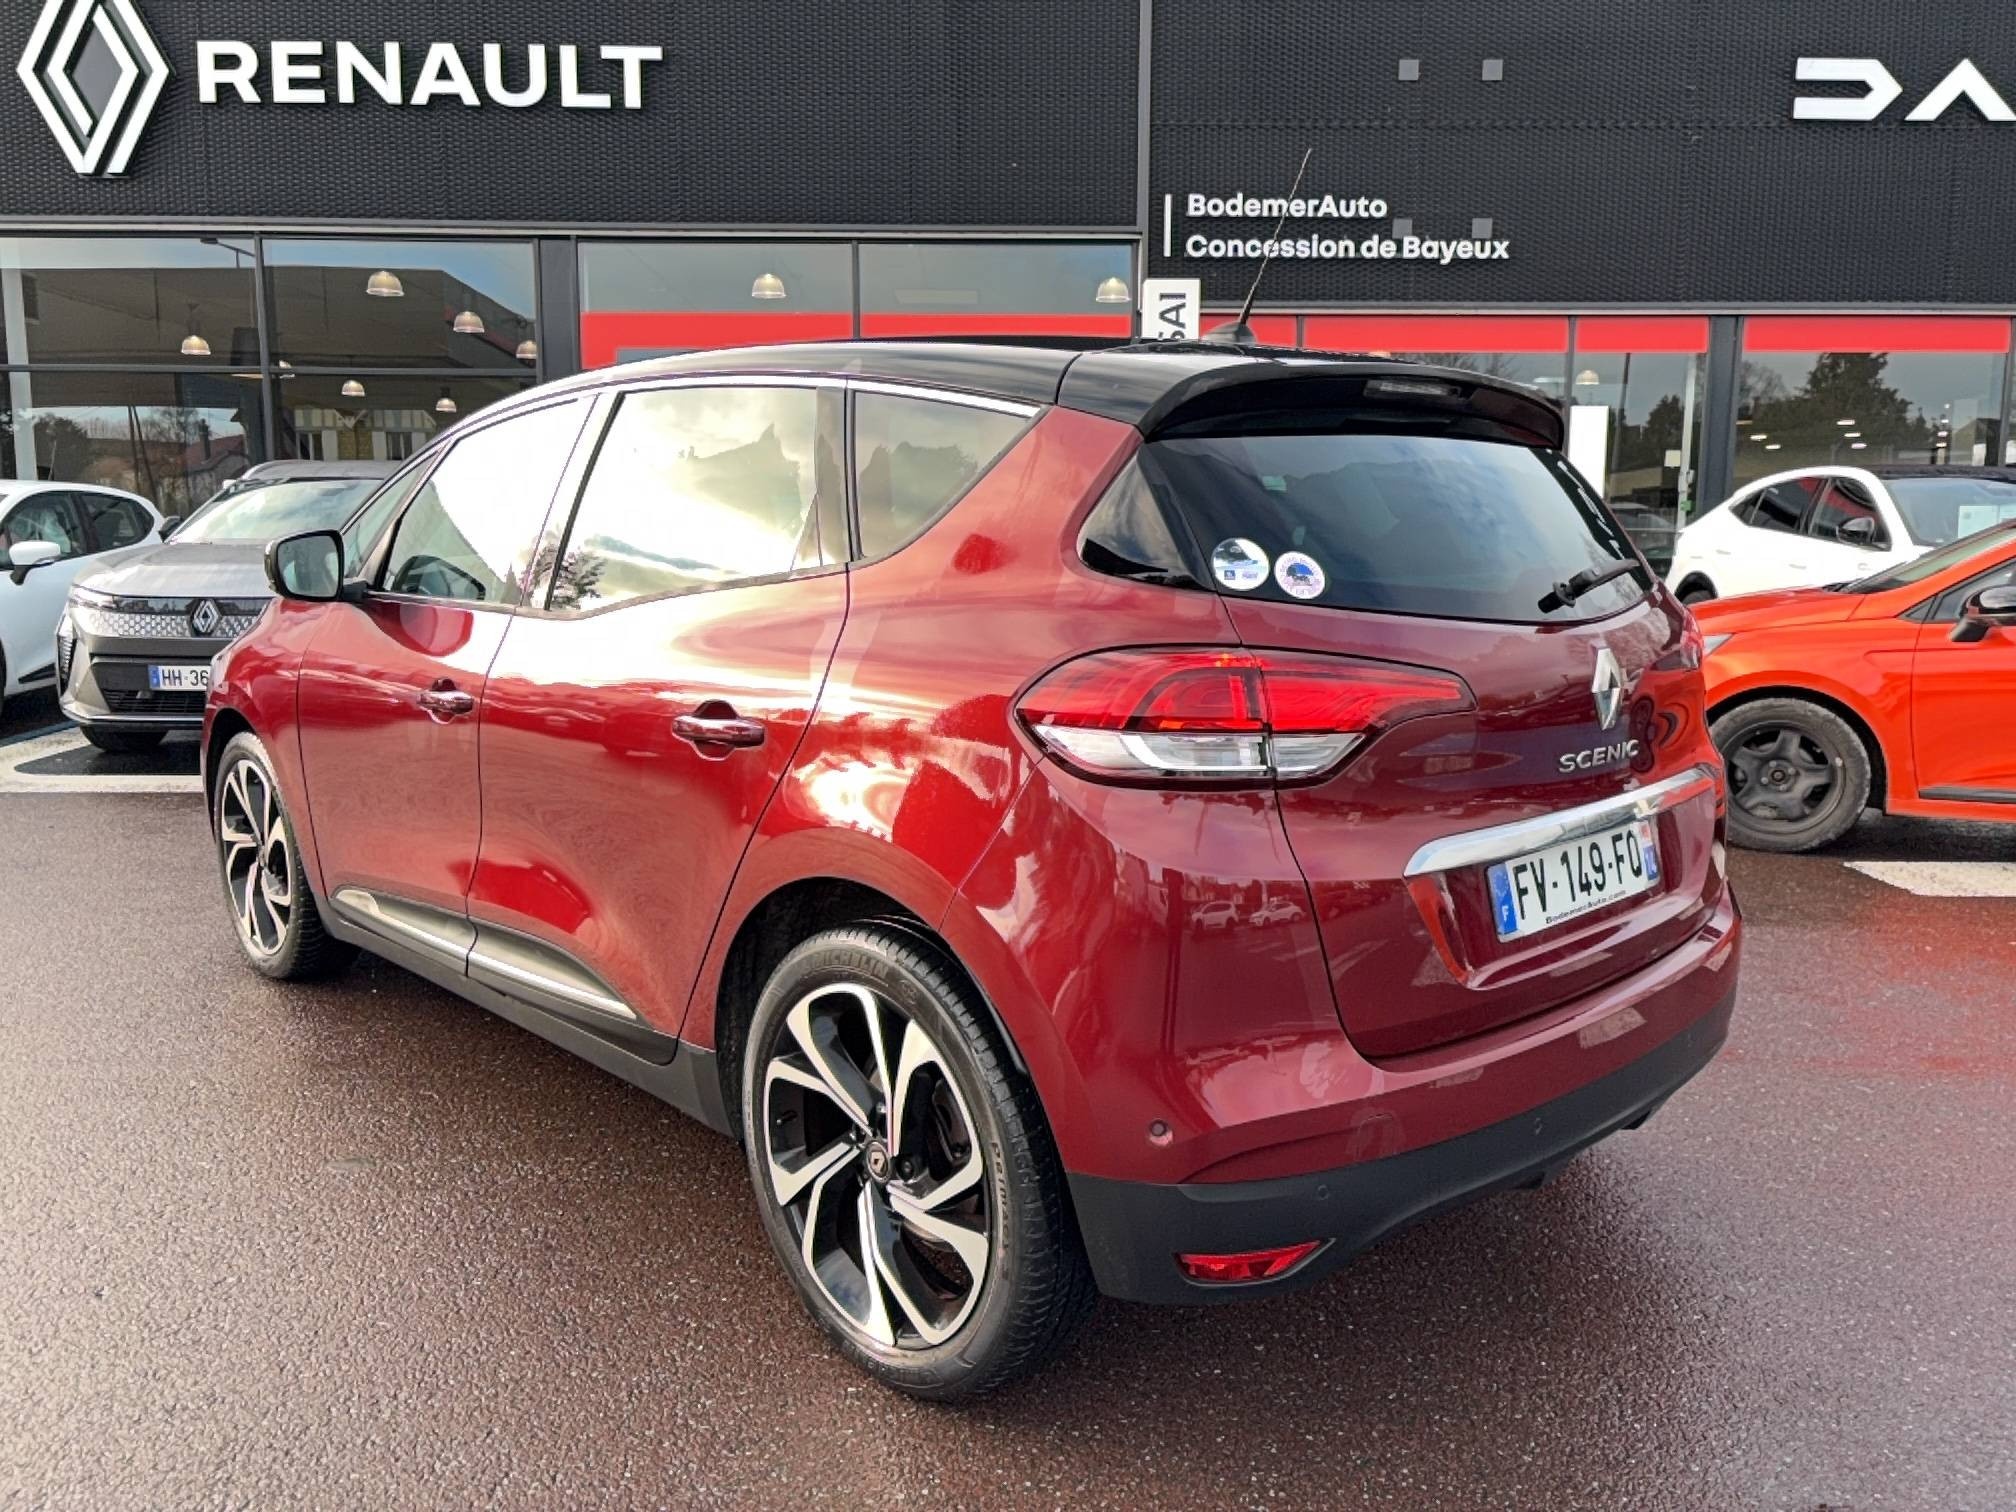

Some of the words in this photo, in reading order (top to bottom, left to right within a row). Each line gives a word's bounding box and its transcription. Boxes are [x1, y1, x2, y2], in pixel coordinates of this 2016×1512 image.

[196, 40, 664, 109] RENAULT
[1793, 57, 2016, 121] DA
[1186, 192, 1388, 218] BodemerAuto
[1185, 233, 1356, 259] Concession
[1360, 234, 1398, 259] de
[1402, 235, 1511, 266] Bayeux
[1558, 739, 1640, 773] SCENIC
